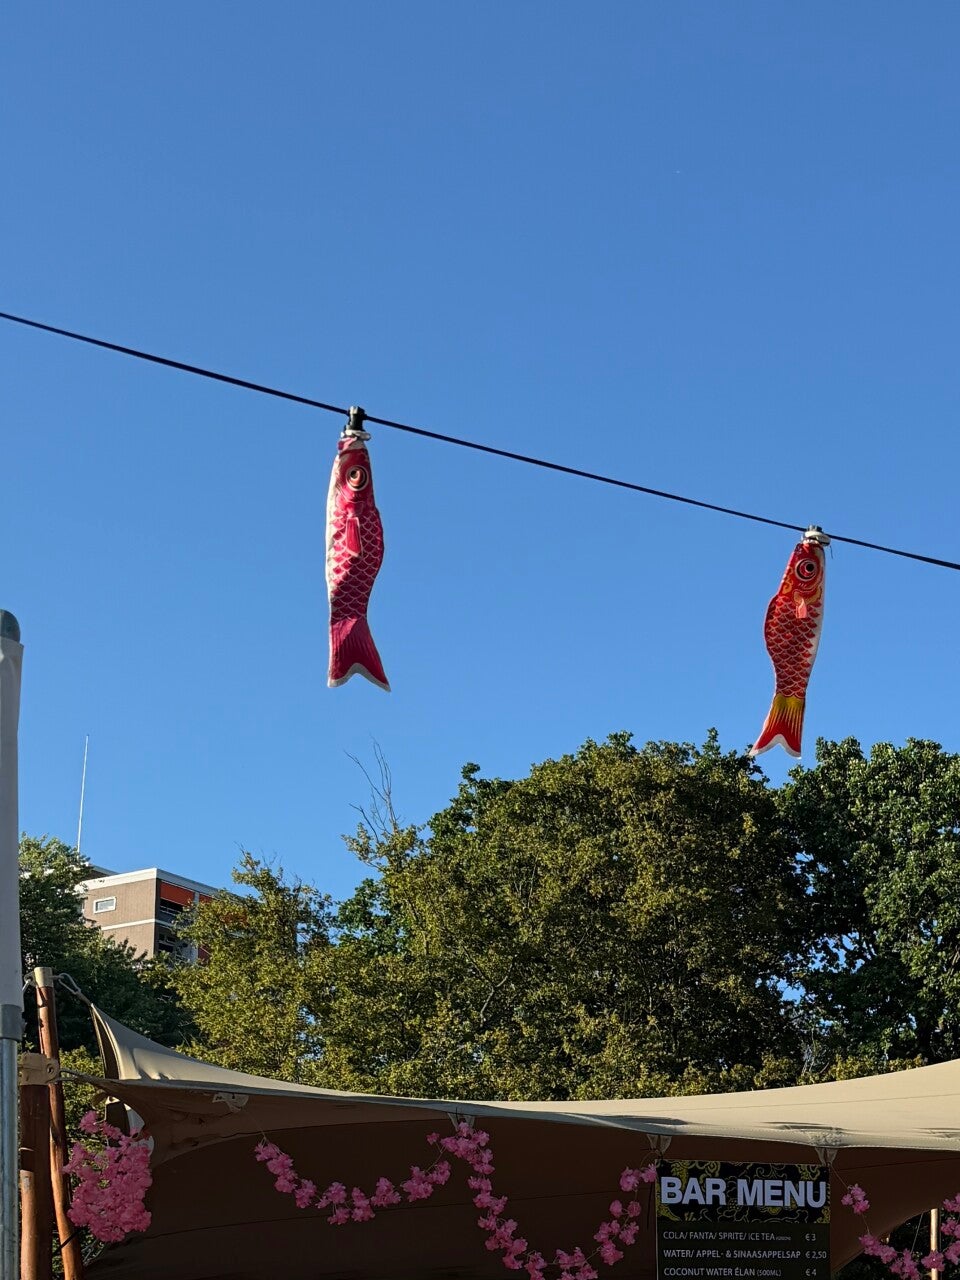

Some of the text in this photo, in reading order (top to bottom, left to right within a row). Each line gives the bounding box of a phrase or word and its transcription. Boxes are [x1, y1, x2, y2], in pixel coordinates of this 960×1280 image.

[660, 1176, 827, 1208] BAR MENU
[663, 1231, 688, 1240] COLA/
[689, 1231, 717, 1240] FANTA/
[718, 1231, 747, 1241] SPRITE/
[748, 1232, 761, 1241] ICE
[761, 1232, 775, 1241] TEA
[805, 1233, 816, 1242] € 3
[663, 1249, 694, 1258] WATER/
[725, 1250, 732, 1259] &
[733, 1250, 801, 1259] SINAASAPPELSAP
[805, 1251, 828, 1260] € 2,50
[664, 1267, 705, 1276] COCONUT
[705, 1267, 733, 1276] WATER
[734, 1266, 756, 1276] ÉLAN
[805, 1268, 816, 1277] € 4
